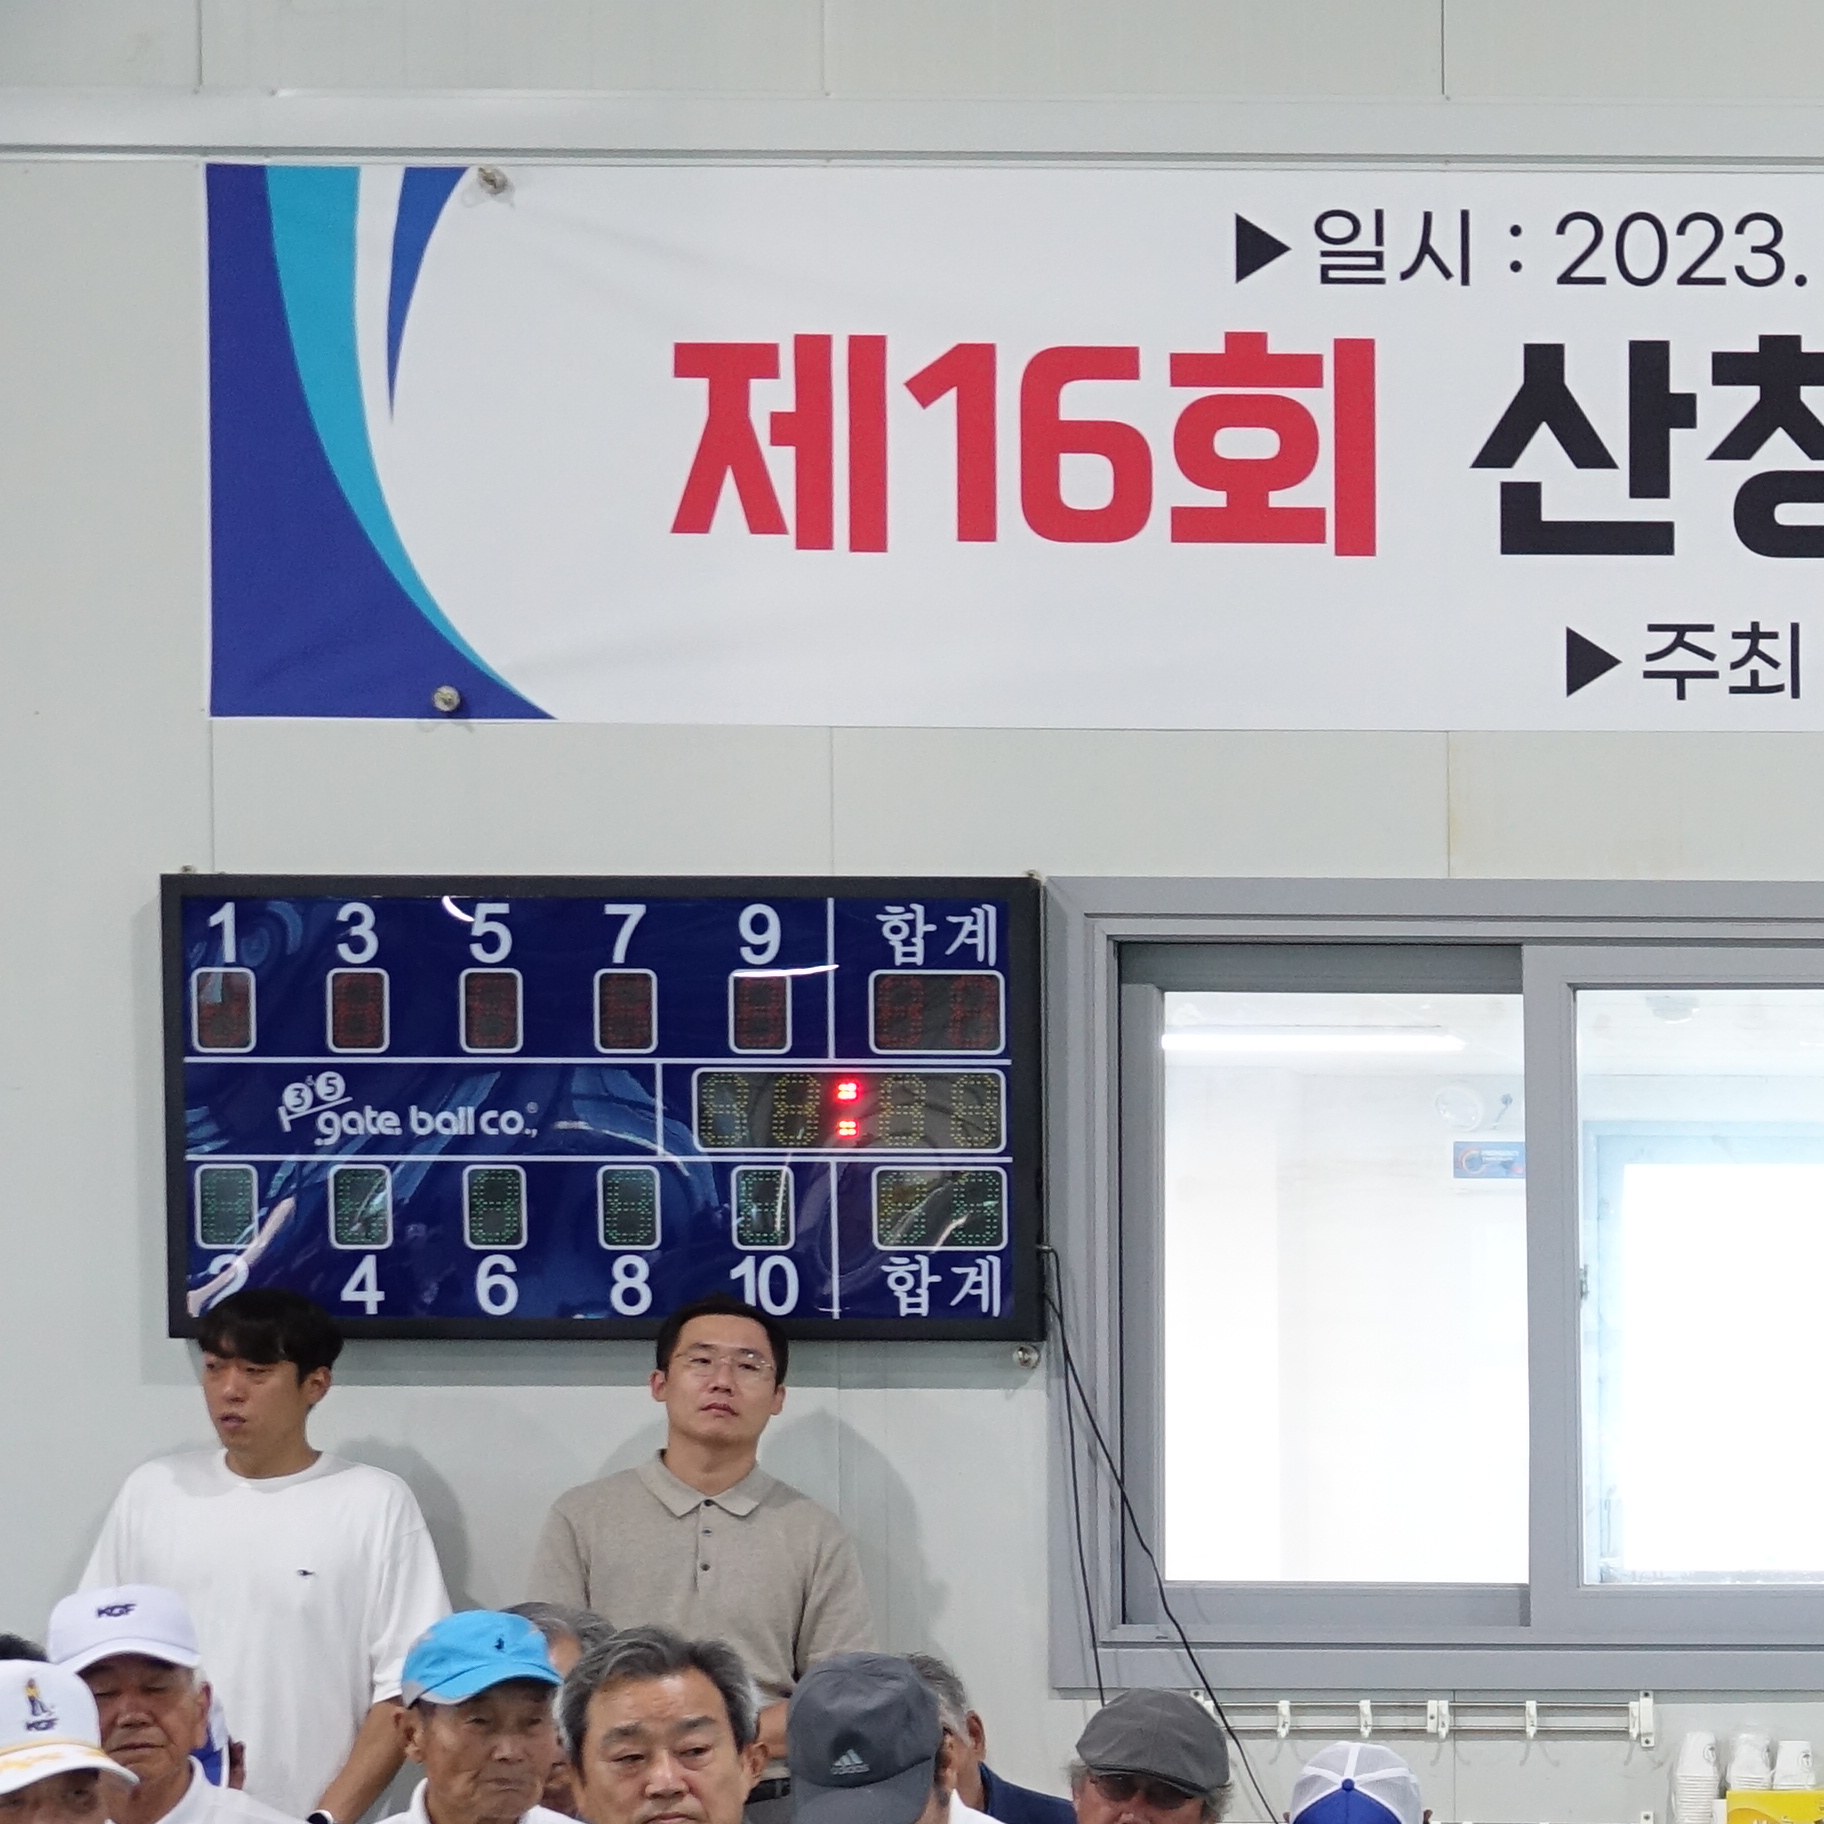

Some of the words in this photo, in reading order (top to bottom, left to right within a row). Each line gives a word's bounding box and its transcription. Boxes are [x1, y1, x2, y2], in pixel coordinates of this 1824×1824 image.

[1315, 209, 1470, 286] 일시
[1555, 211, 1808, 288] 2023.
[670, 331, 1376, 557] 제16회
[1642, 621, 1801, 701] 주최
[207, 903, 235, 963] 1
[337, 902, 379, 964] 3
[470, 902, 512, 963] 5
[604, 904, 647, 963] 7
[739, 904, 781, 965] 9
[876, 903, 998, 966] 합계
[409, 1105, 475, 1136] ball
[340, 1254, 386, 1315] 4
[475, 1254, 519, 1316] 6
[610, 1254, 652, 1316] 8
[730, 1255, 799, 1316] 10
[881, 1255, 1001, 1317] 합계
[97, 1603, 137, 1618] KGF
